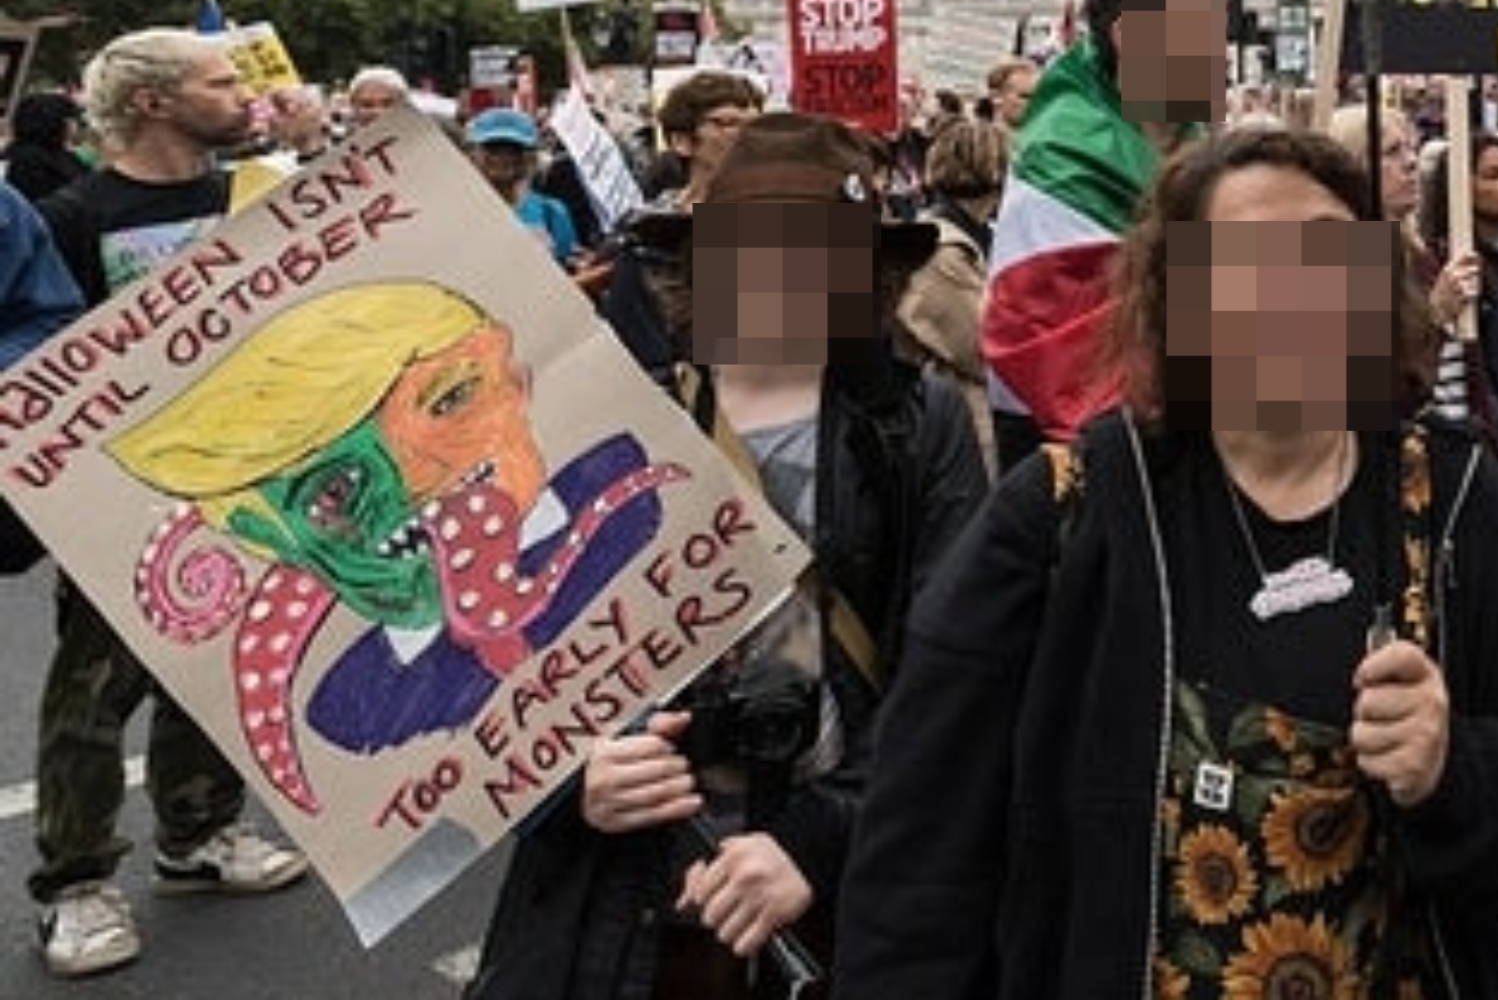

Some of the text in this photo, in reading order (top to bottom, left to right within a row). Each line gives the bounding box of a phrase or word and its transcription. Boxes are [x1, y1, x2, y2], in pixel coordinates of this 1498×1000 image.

[800, 26, 888, 56] TRUMP
[267, 136, 404, 232] ISN'T
[12, 380, 150, 488] UNTIL
[166, 192, 418, 367] OCTOBER
[373, 497, 758, 834] TOO EARLY FOR
[484, 568, 752, 820] MONSTERS
